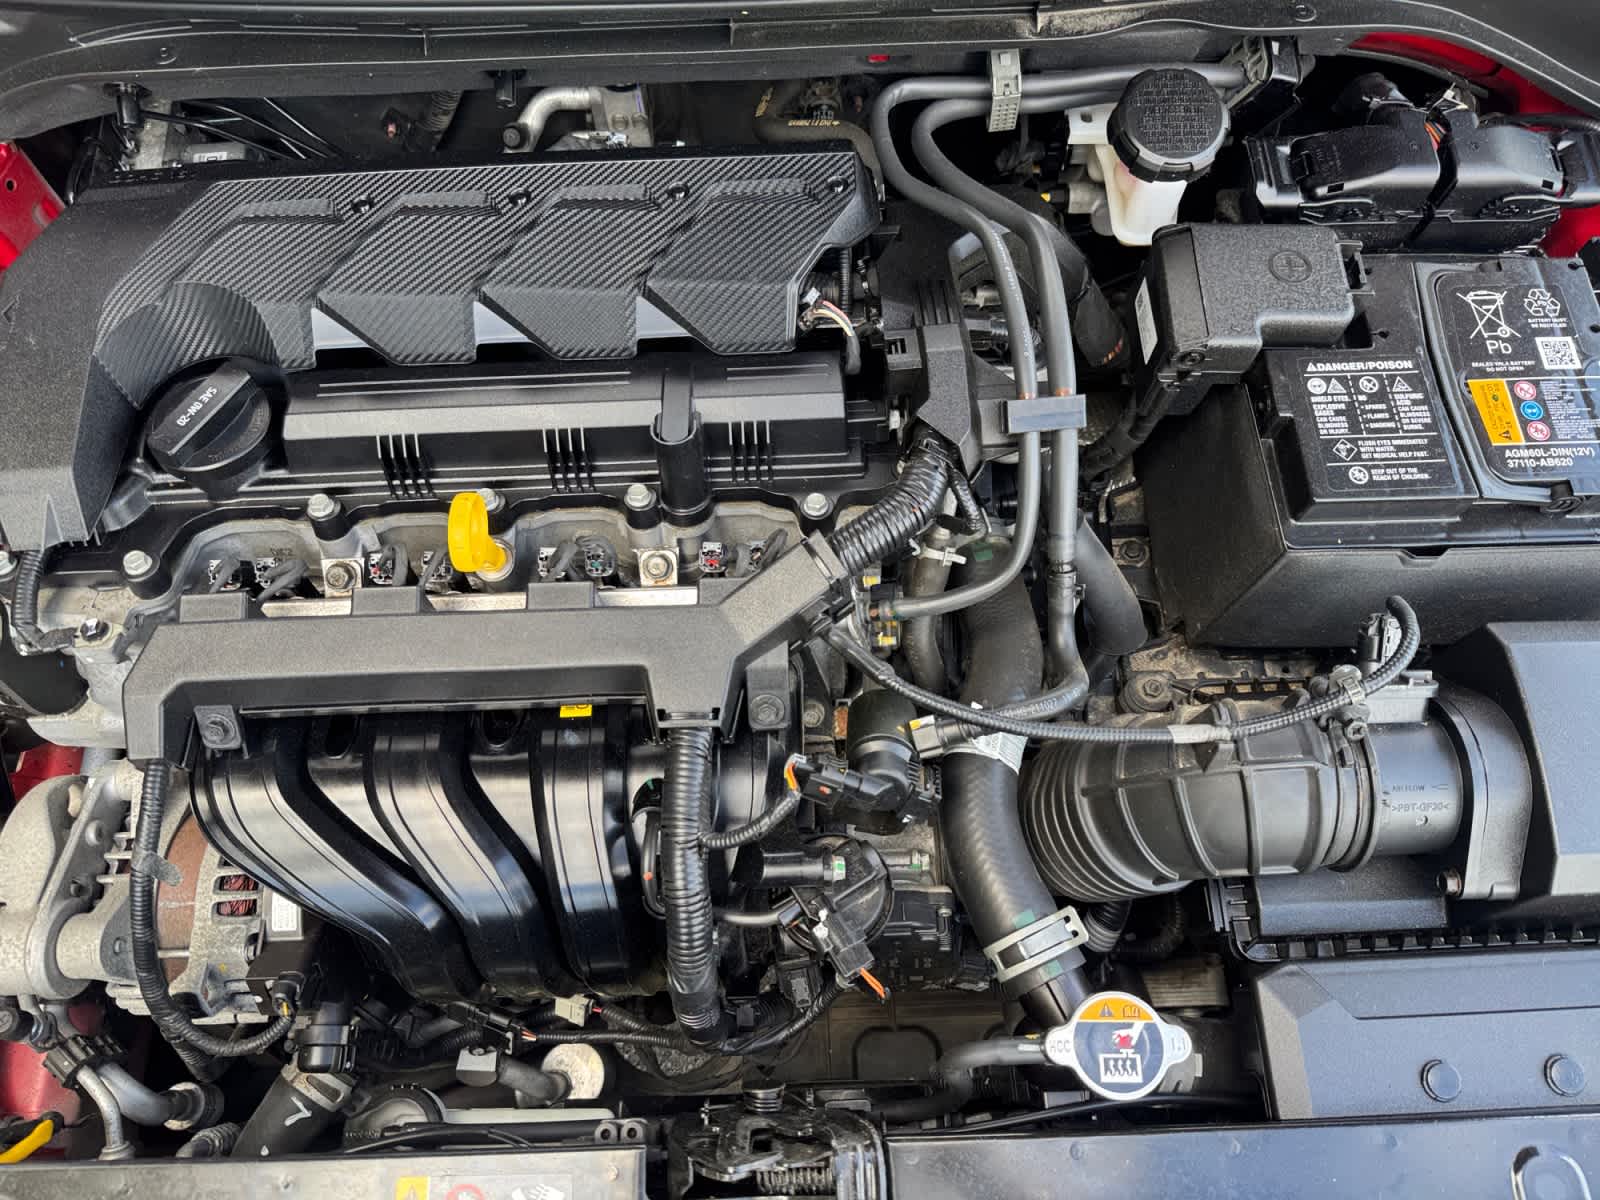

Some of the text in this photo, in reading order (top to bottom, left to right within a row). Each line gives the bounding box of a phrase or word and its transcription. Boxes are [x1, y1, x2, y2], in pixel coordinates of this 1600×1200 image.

[1486, 340, 1512, 354] Pb
[1316, 360, 1413, 371] DANGER/POISON
[176, 387, 217, 426] SAE 0W-20
